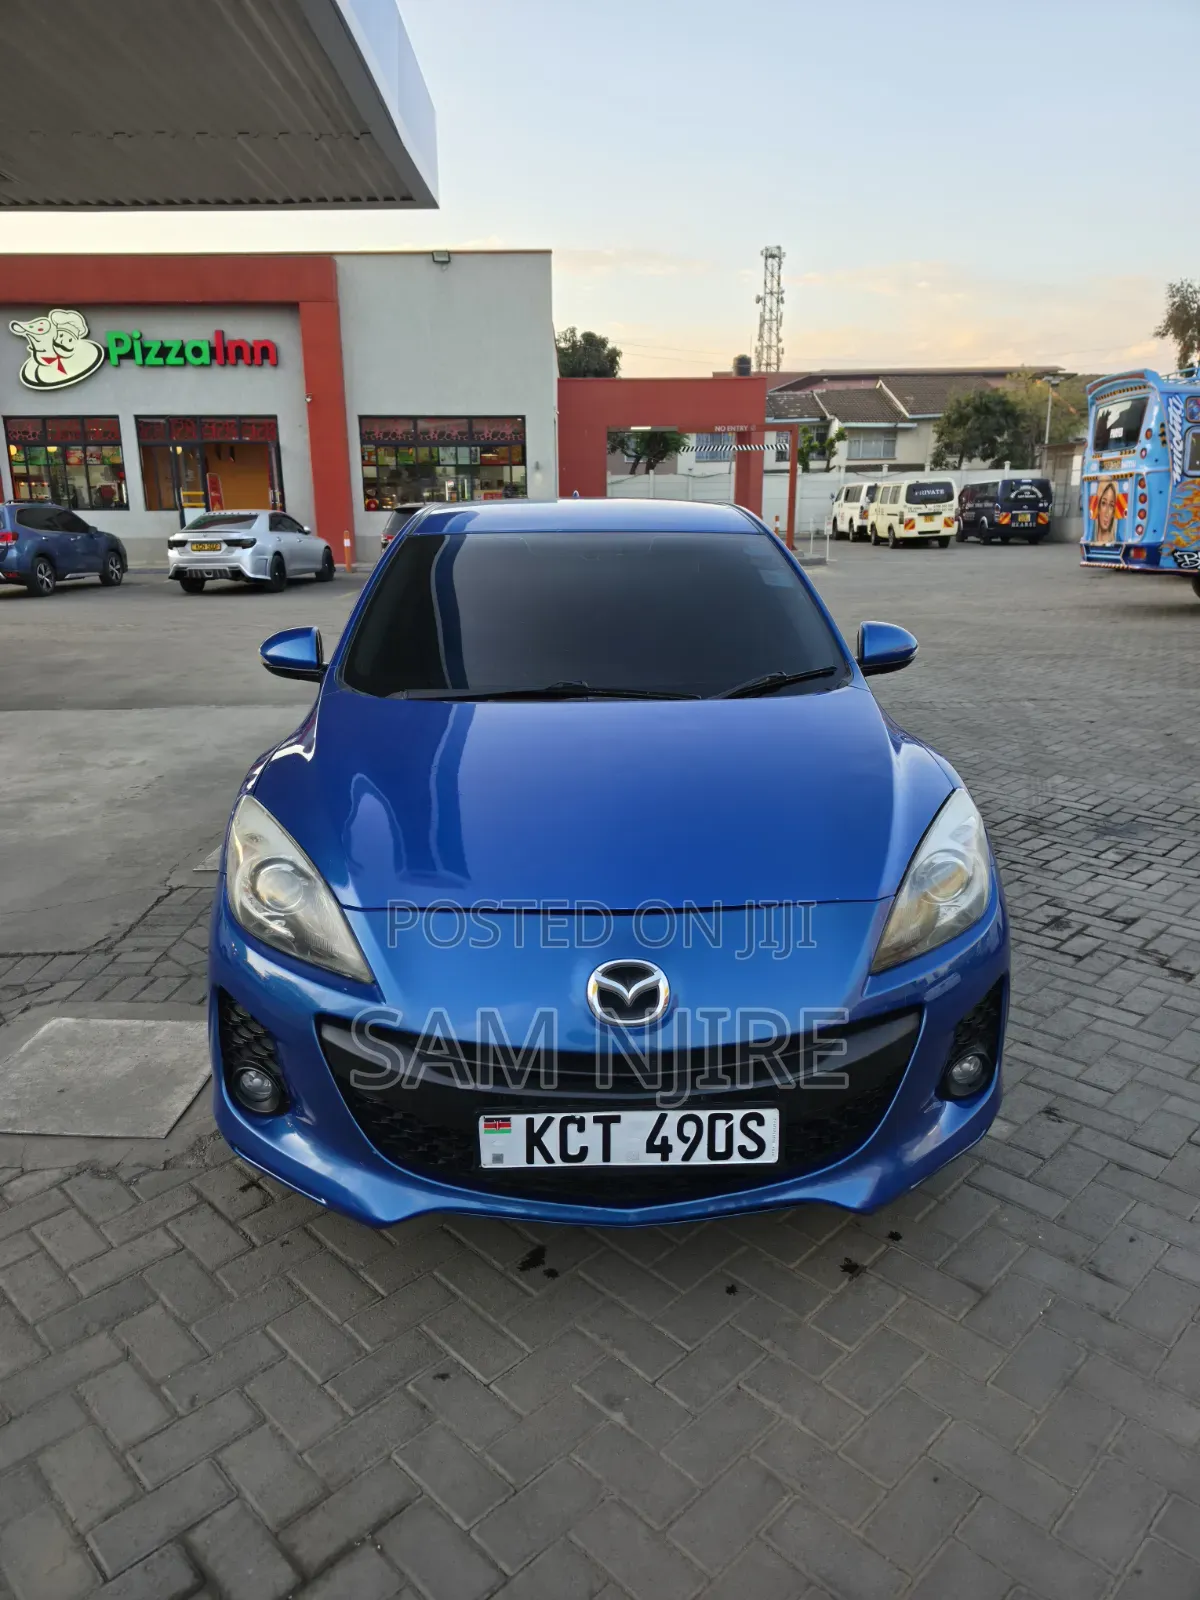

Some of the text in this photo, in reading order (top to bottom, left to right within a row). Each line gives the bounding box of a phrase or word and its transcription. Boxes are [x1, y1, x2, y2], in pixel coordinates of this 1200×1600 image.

[915, 488, 945, 496] PRIVATE
[525, 1114, 621, 1165] KCT
[645, 1111, 767, 1162] 490S
